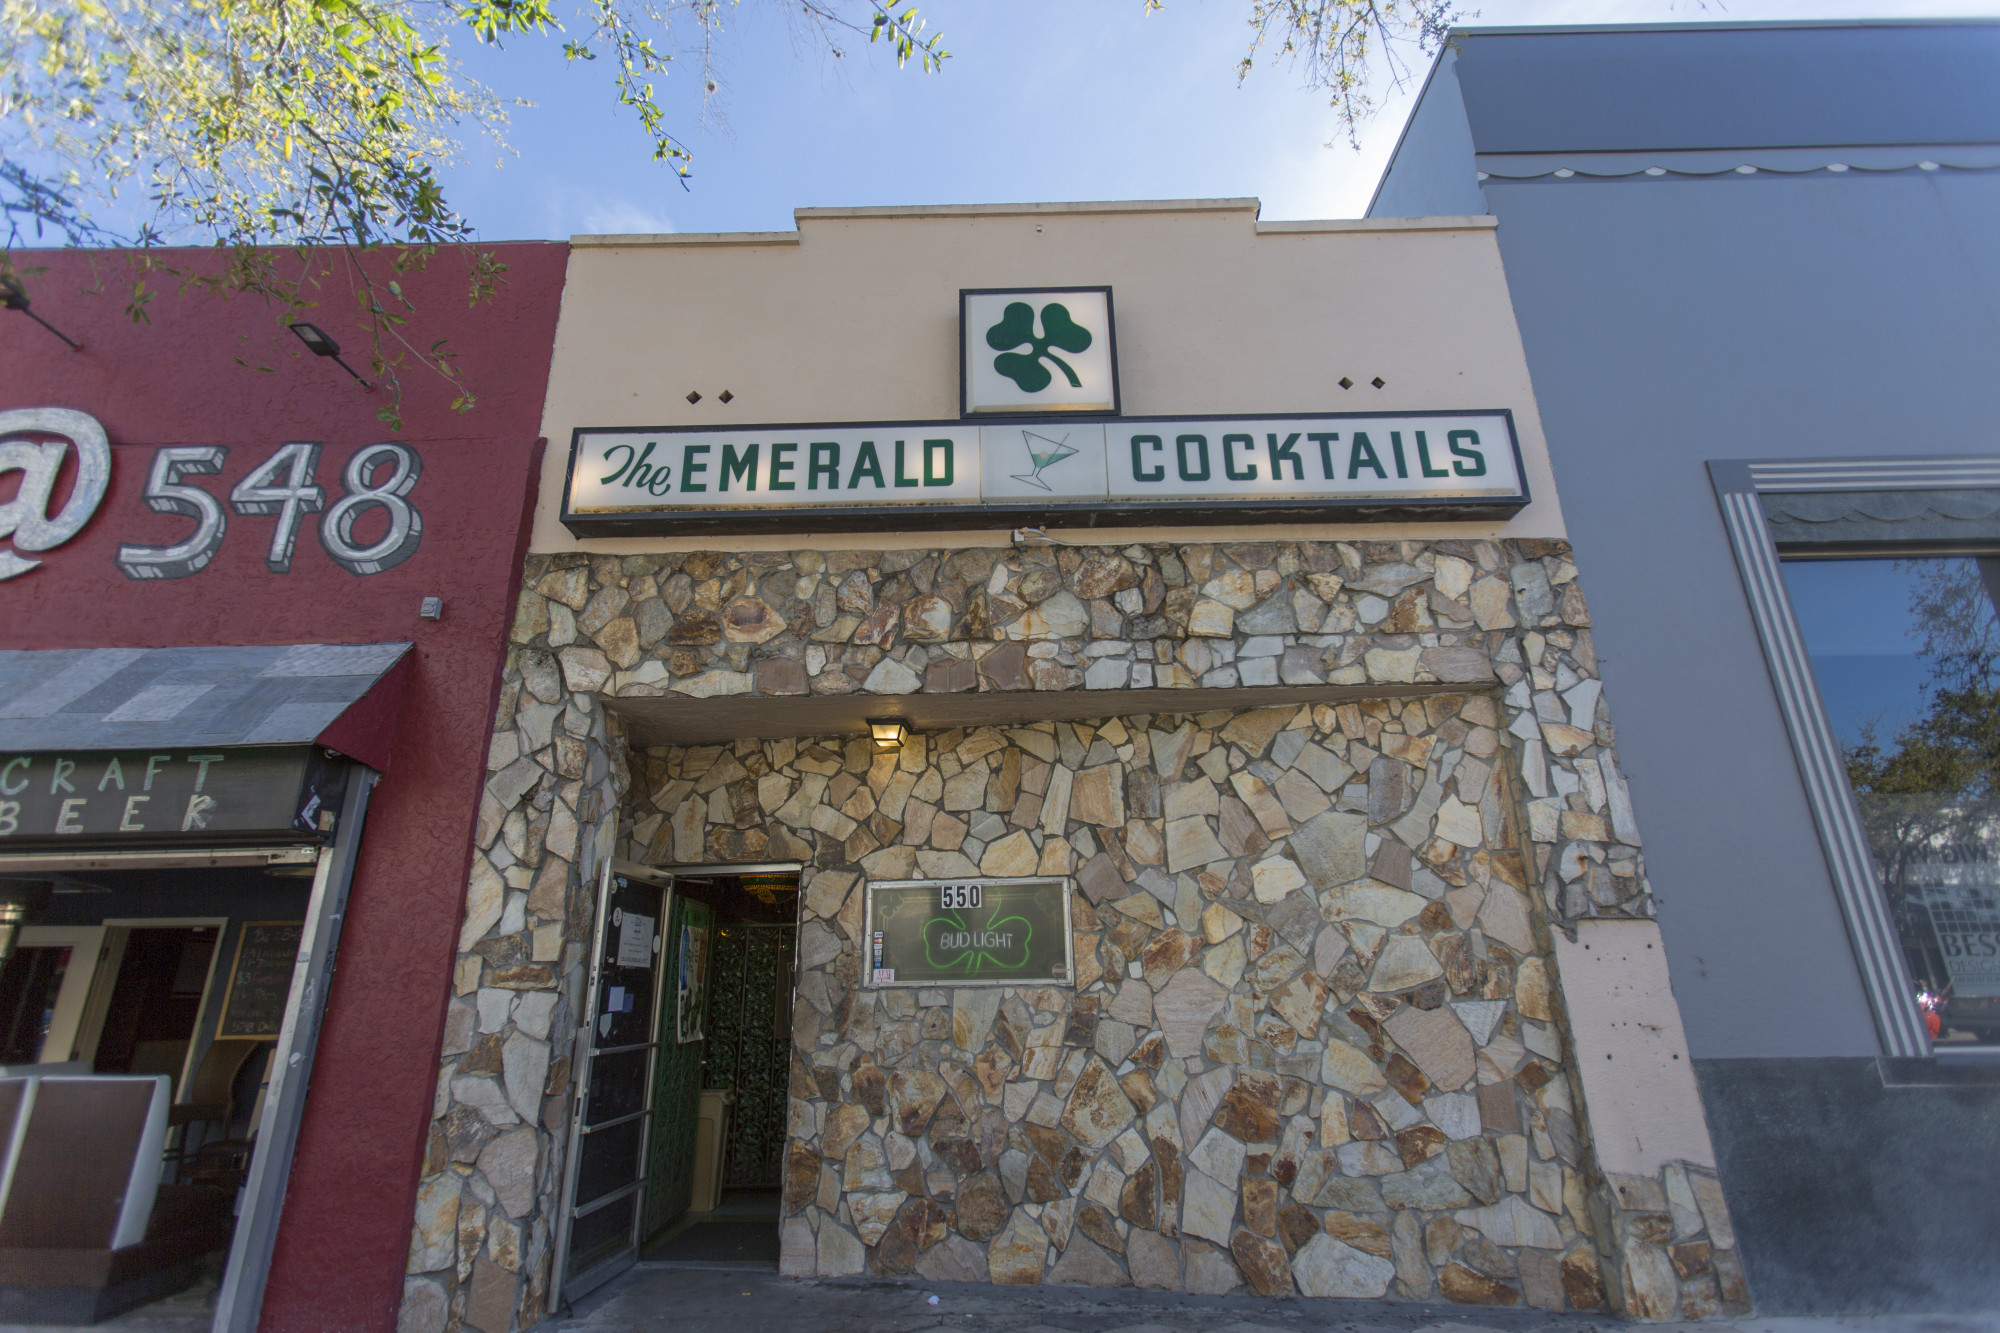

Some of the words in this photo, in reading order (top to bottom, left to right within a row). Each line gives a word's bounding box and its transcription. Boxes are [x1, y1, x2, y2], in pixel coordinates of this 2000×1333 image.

[600, 441, 671, 497] The
[680, 438, 954, 493] EMERALD
[1130, 429, 1488, 482] COCKTAILS
[114, 440, 423, 581] 548
[0, 754, 225, 796] CRAFT
[0, 794, 217, 836] BEER
[943, 885, 982, 908] 550
[940, 932, 970, 950] BUD
[973, 932, 1013, 949] LIGHT
[1940, 932, 2000, 957] BES
